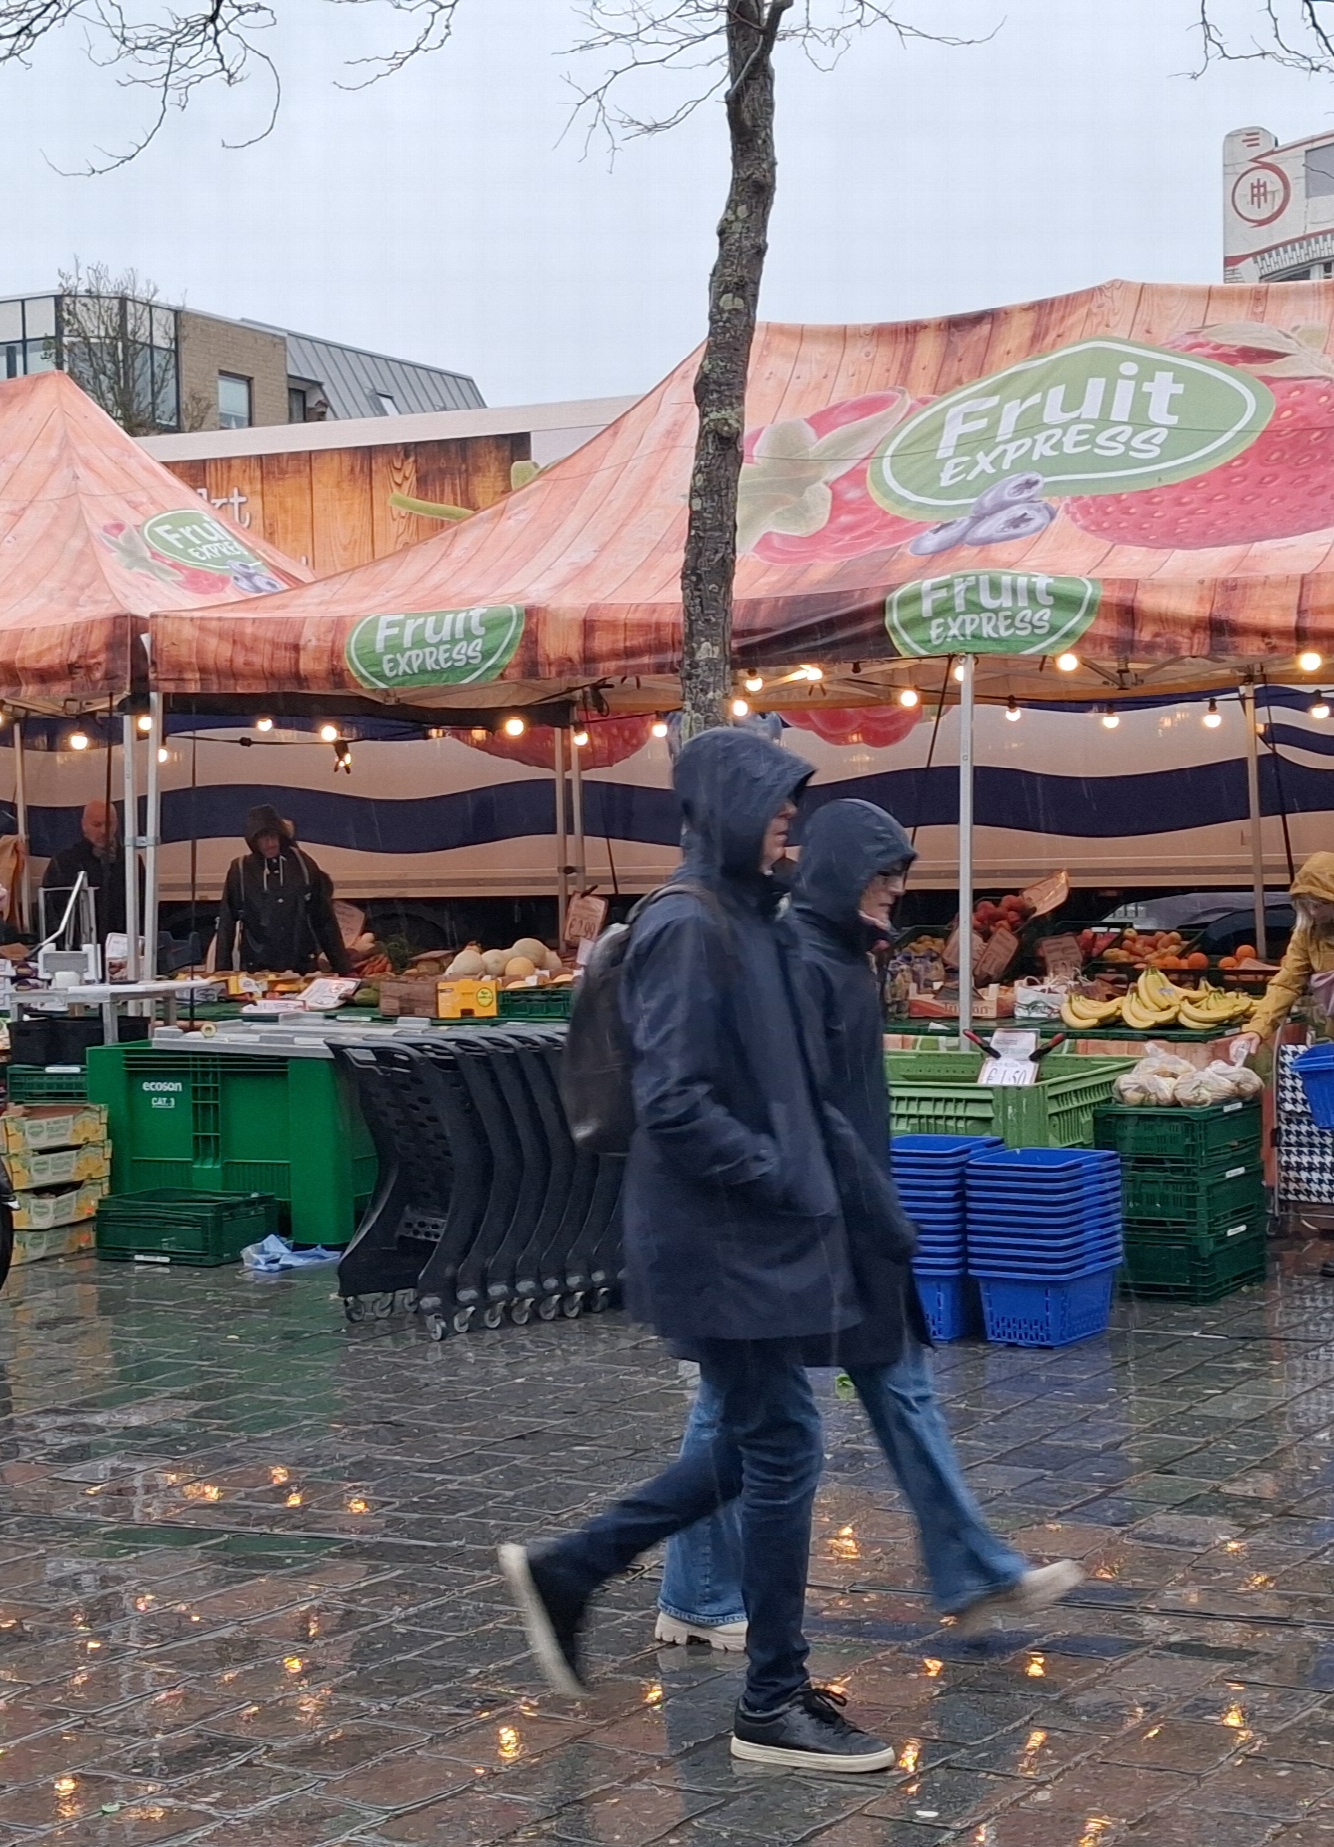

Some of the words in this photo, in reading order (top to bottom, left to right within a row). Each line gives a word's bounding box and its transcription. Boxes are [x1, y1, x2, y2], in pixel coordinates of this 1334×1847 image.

[936, 361, 1185, 460] Fruit
[939, 423, 1168, 487] EXPRESS
[921, 574, 1055, 618] Fruit
[375, 606, 489, 653] Fruit
[930, 607, 1052, 646] EXPRESS
[382, 637, 483, 678] EXPRESS
